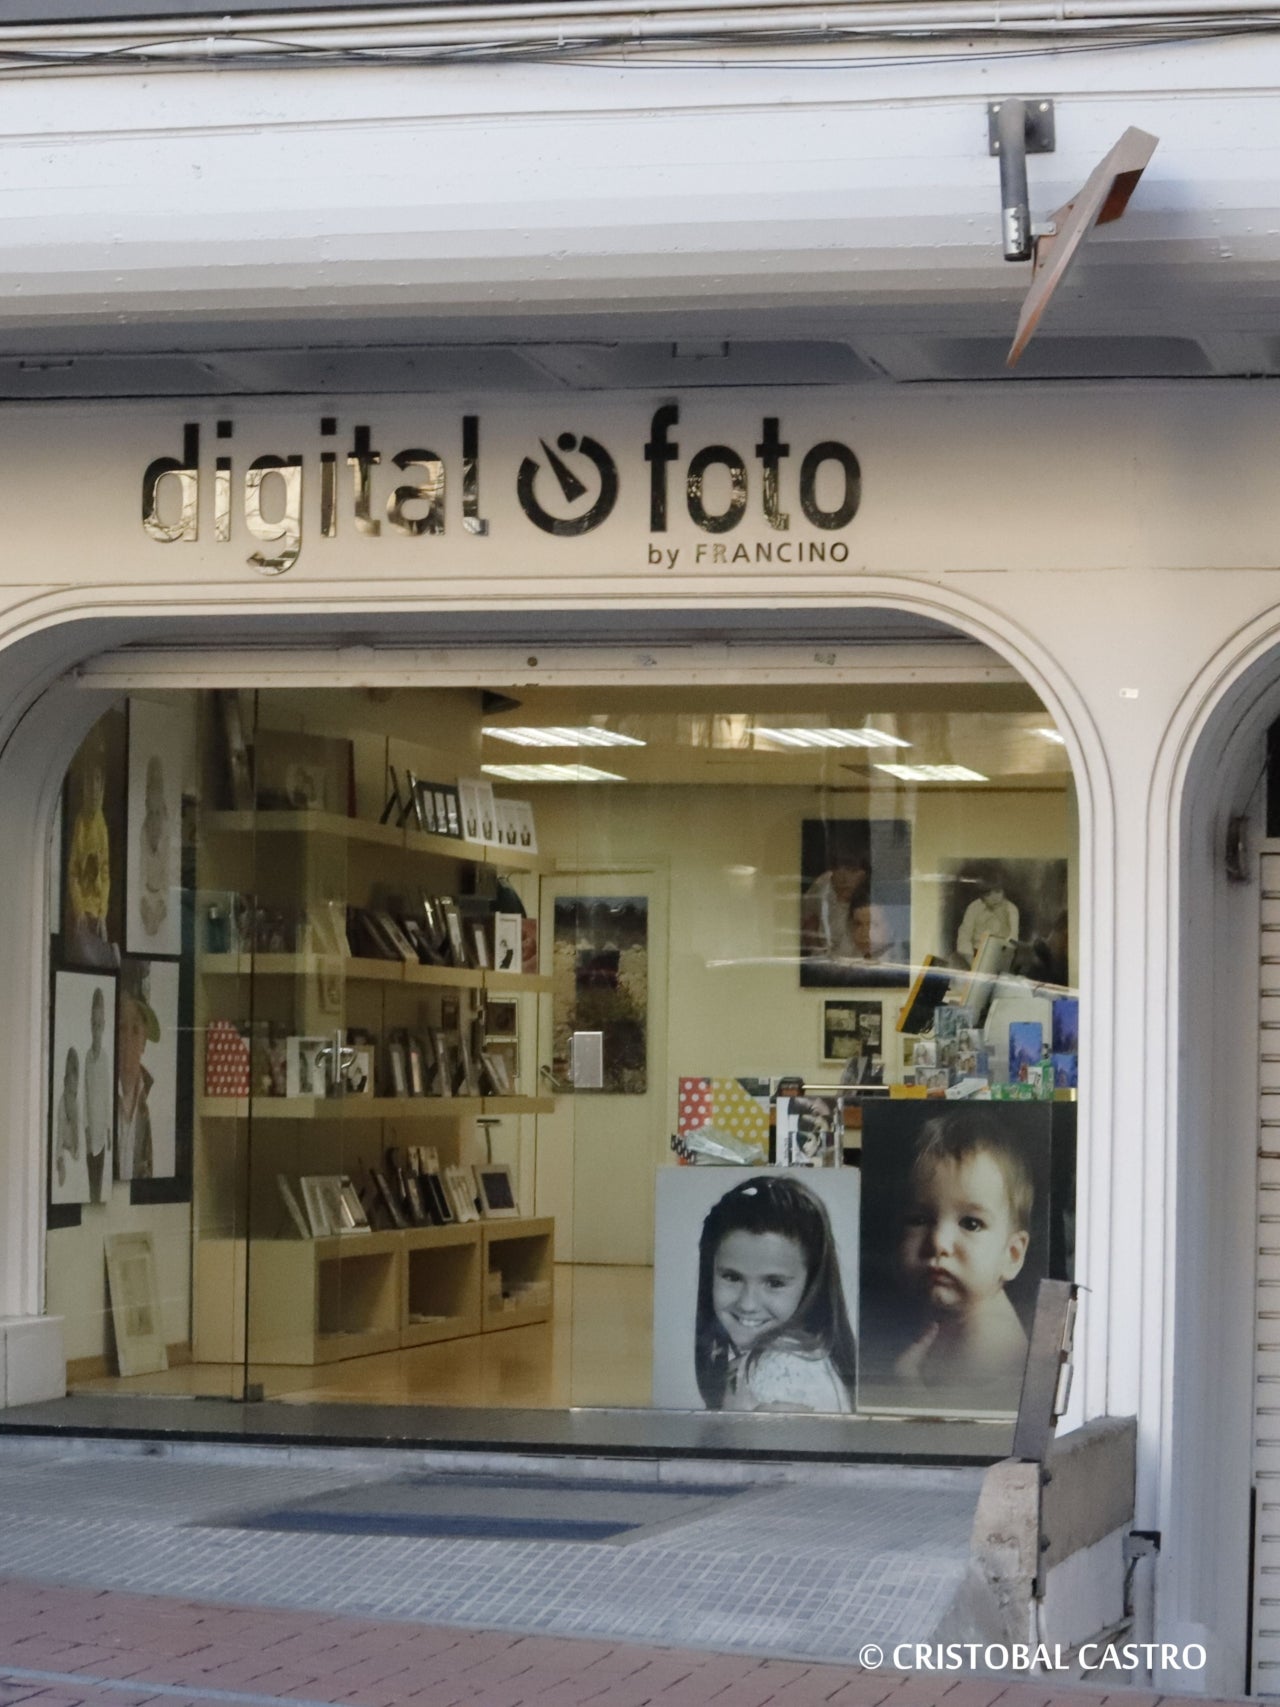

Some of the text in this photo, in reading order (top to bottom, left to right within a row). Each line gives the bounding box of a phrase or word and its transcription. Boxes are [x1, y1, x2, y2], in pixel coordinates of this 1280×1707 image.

[141, 403, 862, 576] digital foto
[647, 541, 851, 568] by FRANCINO
